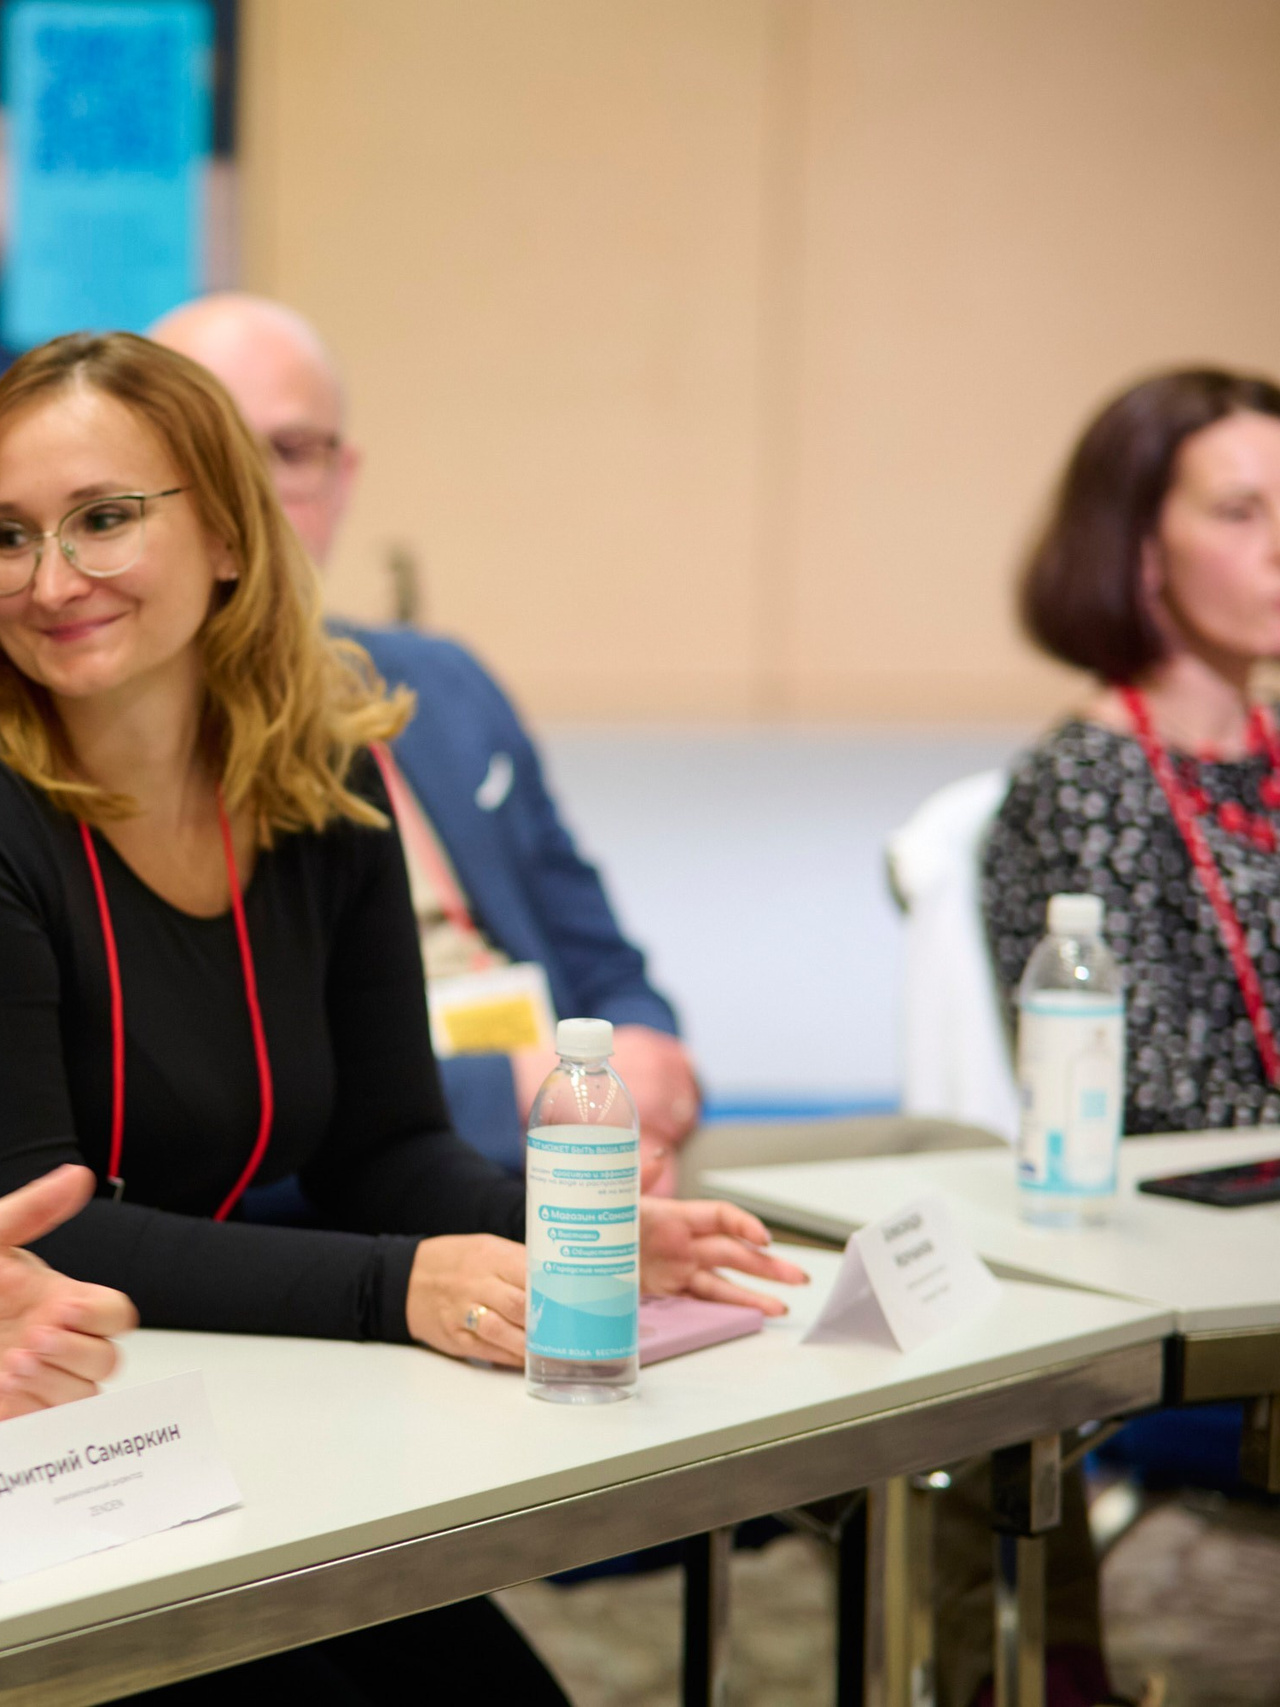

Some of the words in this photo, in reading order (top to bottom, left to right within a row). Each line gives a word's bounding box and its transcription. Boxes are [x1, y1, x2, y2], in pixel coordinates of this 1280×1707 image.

[542, 1142, 569, 1153] МОЖЕТ
[571, 1146, 594, 1154] БЫТЬ
[596, 1145, 618, 1154] ВАША
[551, 1210, 596, 1221] Магазин
[569, 1348, 592, 1357] ВОДА
[85, 1424, 181, 1465] Самаркин
